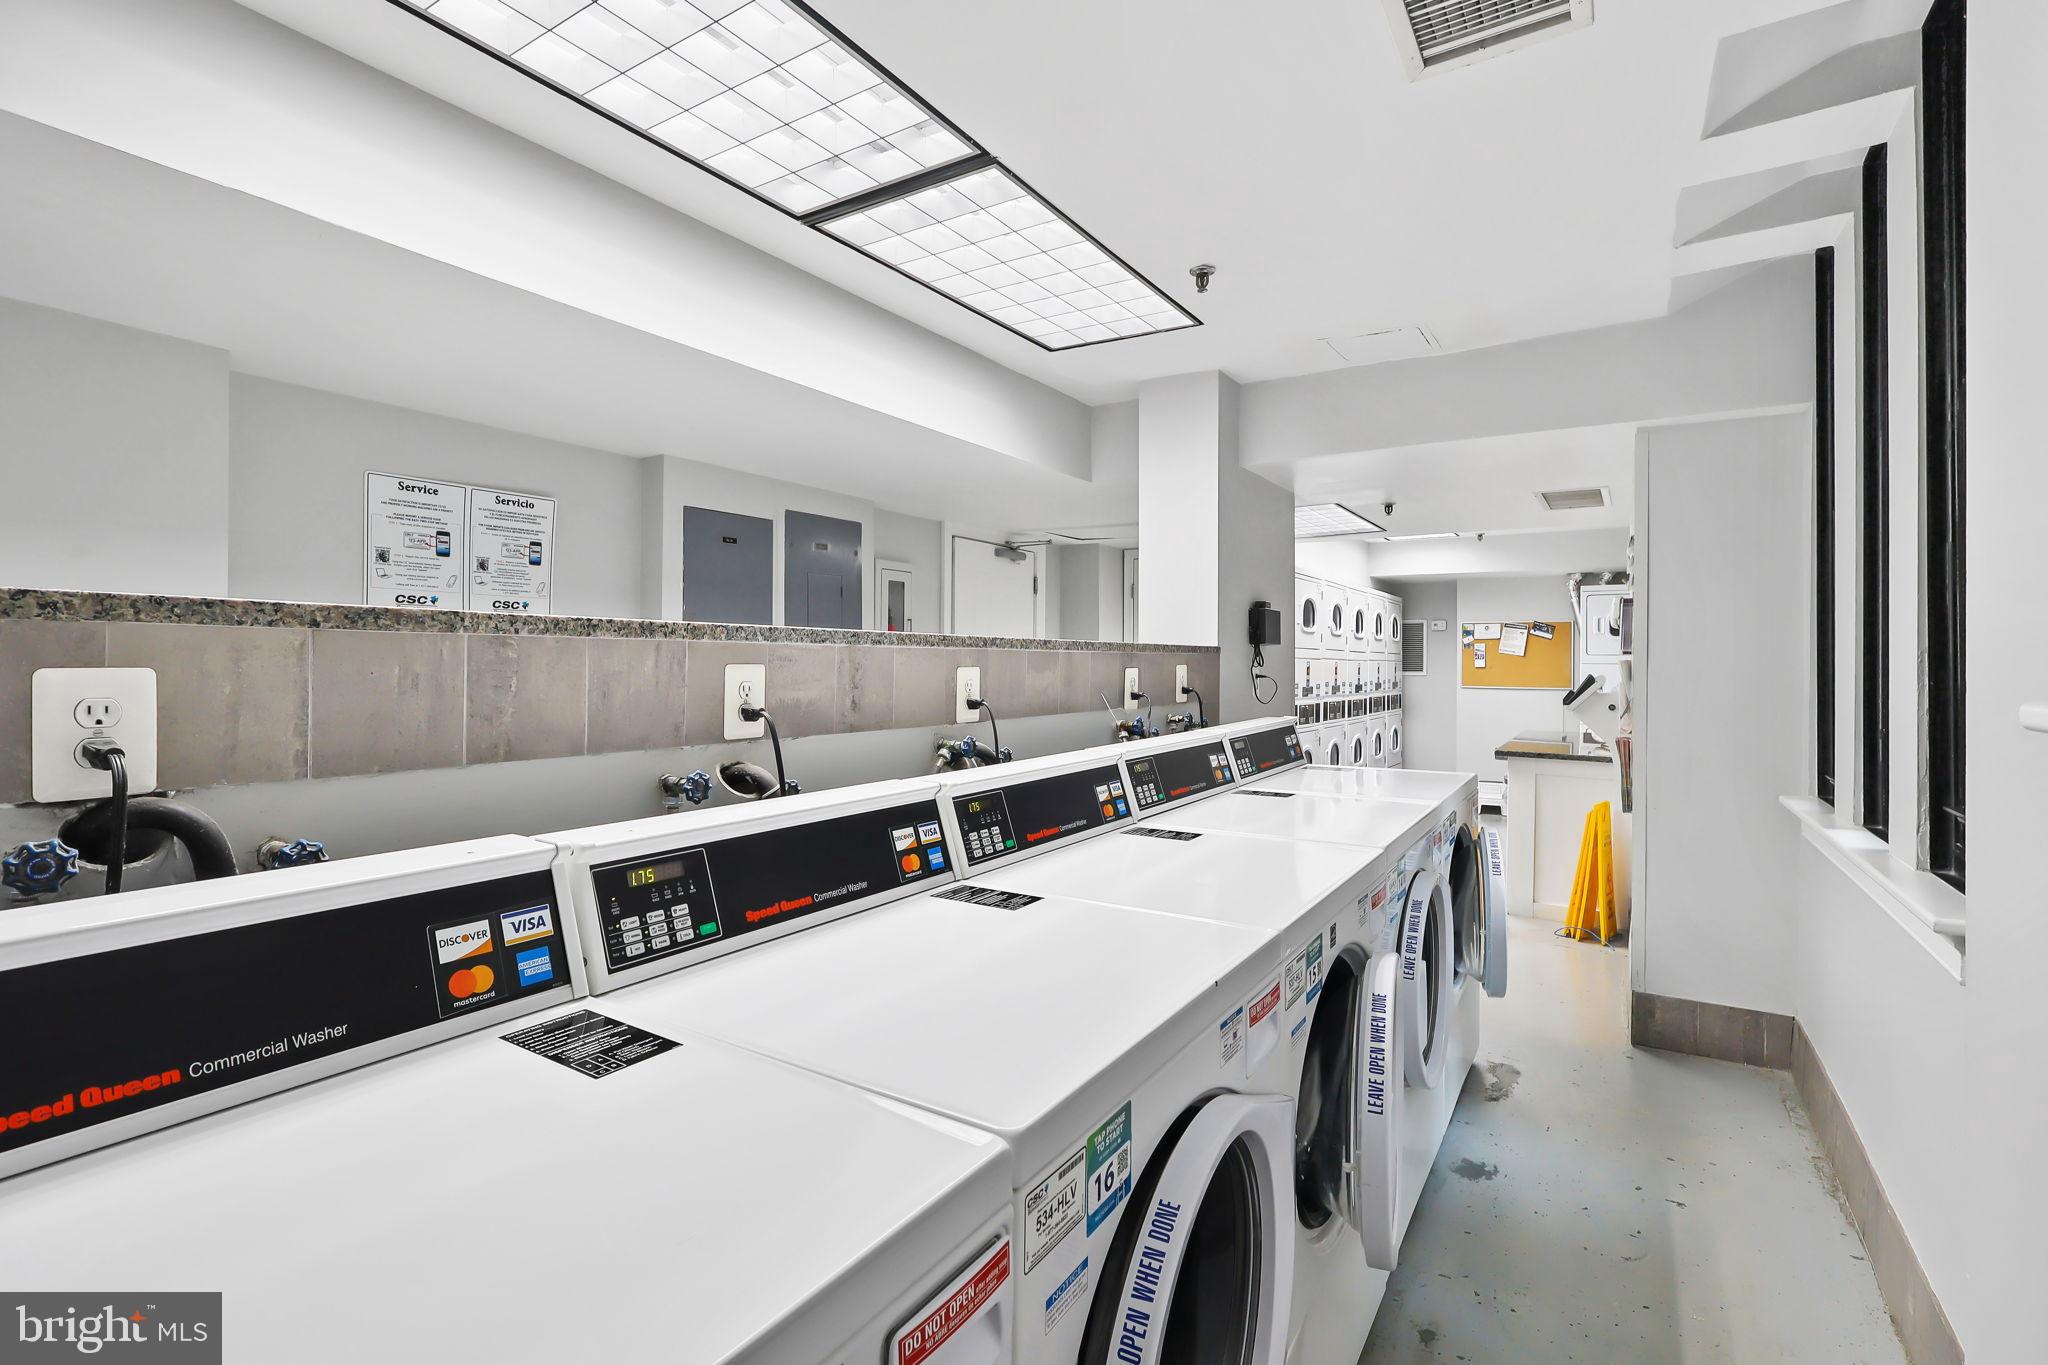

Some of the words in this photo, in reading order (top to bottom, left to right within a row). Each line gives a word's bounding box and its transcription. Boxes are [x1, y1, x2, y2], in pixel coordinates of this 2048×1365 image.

[397, 481, 439, 496] Service
[495, 495, 535, 509] Servicio
[394, 594, 428, 605] CSC
[492, 600, 520, 610] CSC
[922, 827, 938, 837] VISA
[745, 903, 780, 922] Speed
[780, 895, 813, 912] Queen
[813, 885, 848, 903] Commercial
[847, 881, 868, 893] Washer
[1411, 899, 1424, 914] DONE
[509, 915, 547, 934] VISA
[1408, 914, 1420, 933] WHEN
[438, 929, 488, 949] DISCOVER
[1405, 935, 1418, 955] OPEN
[518, 956, 549, 969] AMERICAN
[1403, 956, 1416, 981] LEAVE
[1308, 965, 1317, 987] 15
[453, 990, 496, 1008] mastercard
[1372, 992, 1387, 1014] DONE
[1370, 1015, 1386, 1044] WHEN
[80, 1068, 181, 1108] Queen
[188, 1038, 288, 1078] Commercial
[292, 1023, 349, 1049] Washer
[1369, 1046, 1385, 1076] OPEN
[1367, 1077, 1384, 1116] LEAVE
[1094, 1130, 1106, 1145] TAP
[1096, 1142, 1105, 1155] TO
[1105, 1123, 1124, 1145] START
[1094, 1160, 1115, 1203] 16
[1027, 1188, 1044, 1209] CSC
[1036, 1181, 1078, 1233] 534-HLV
[1147, 1199, 1181, 1244] DONE
[1051, 1265, 1083, 1303] NOTICE
[1130, 1245, 1167, 1303] WHEN
[905, 1331, 921, 1356] DO
[925, 1308, 947, 1338] NOT
[949, 1283, 975, 1318] OPEN
[1117, 1306, 1151, 1365] OPEN
